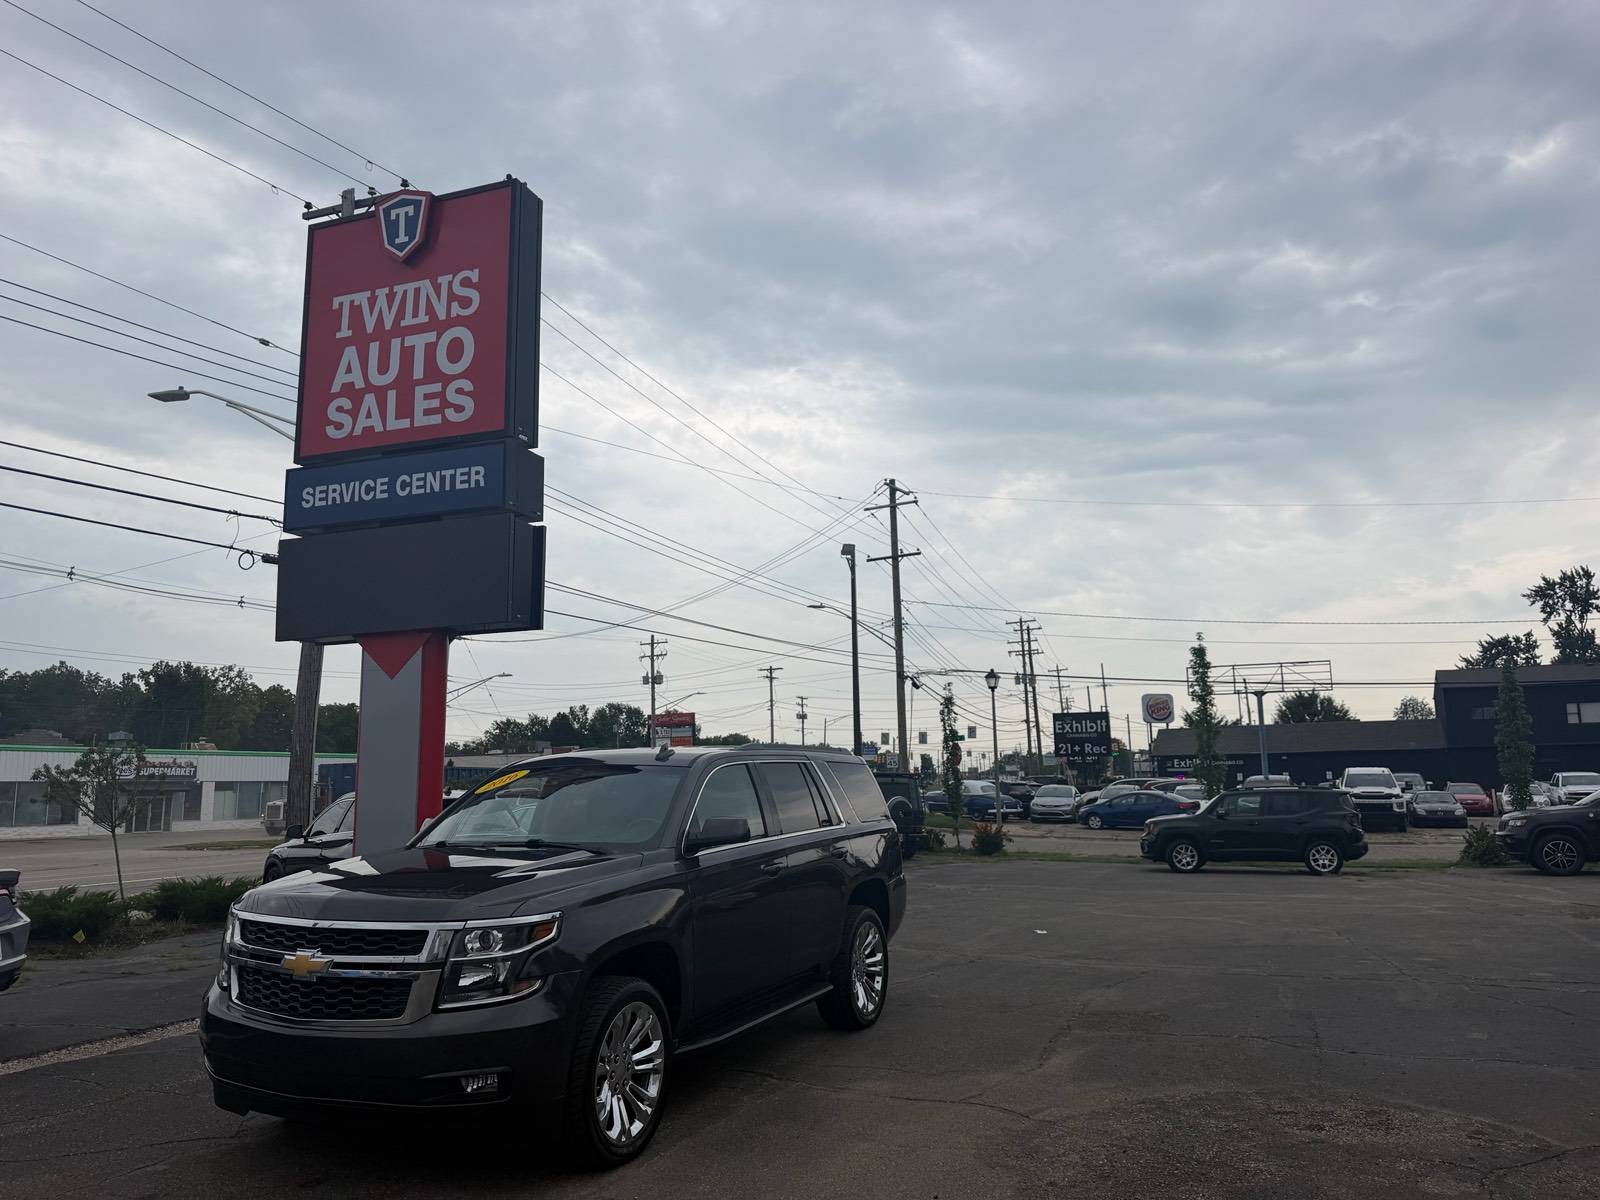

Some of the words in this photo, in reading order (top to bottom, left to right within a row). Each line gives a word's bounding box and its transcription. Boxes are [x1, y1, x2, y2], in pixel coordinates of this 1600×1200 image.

[390, 205, 415, 244] T
[332, 268, 481, 339] TWINS
[330, 327, 475, 393] AUTO
[325, 378, 475, 439] SALES
[300, 476, 389, 509] SERVICE
[396, 465, 486, 498] CENTER
[1055, 720, 1107, 733] Exhibit
[1058, 743, 1081, 754] 21+
[1085, 743, 1107, 754] Rec
